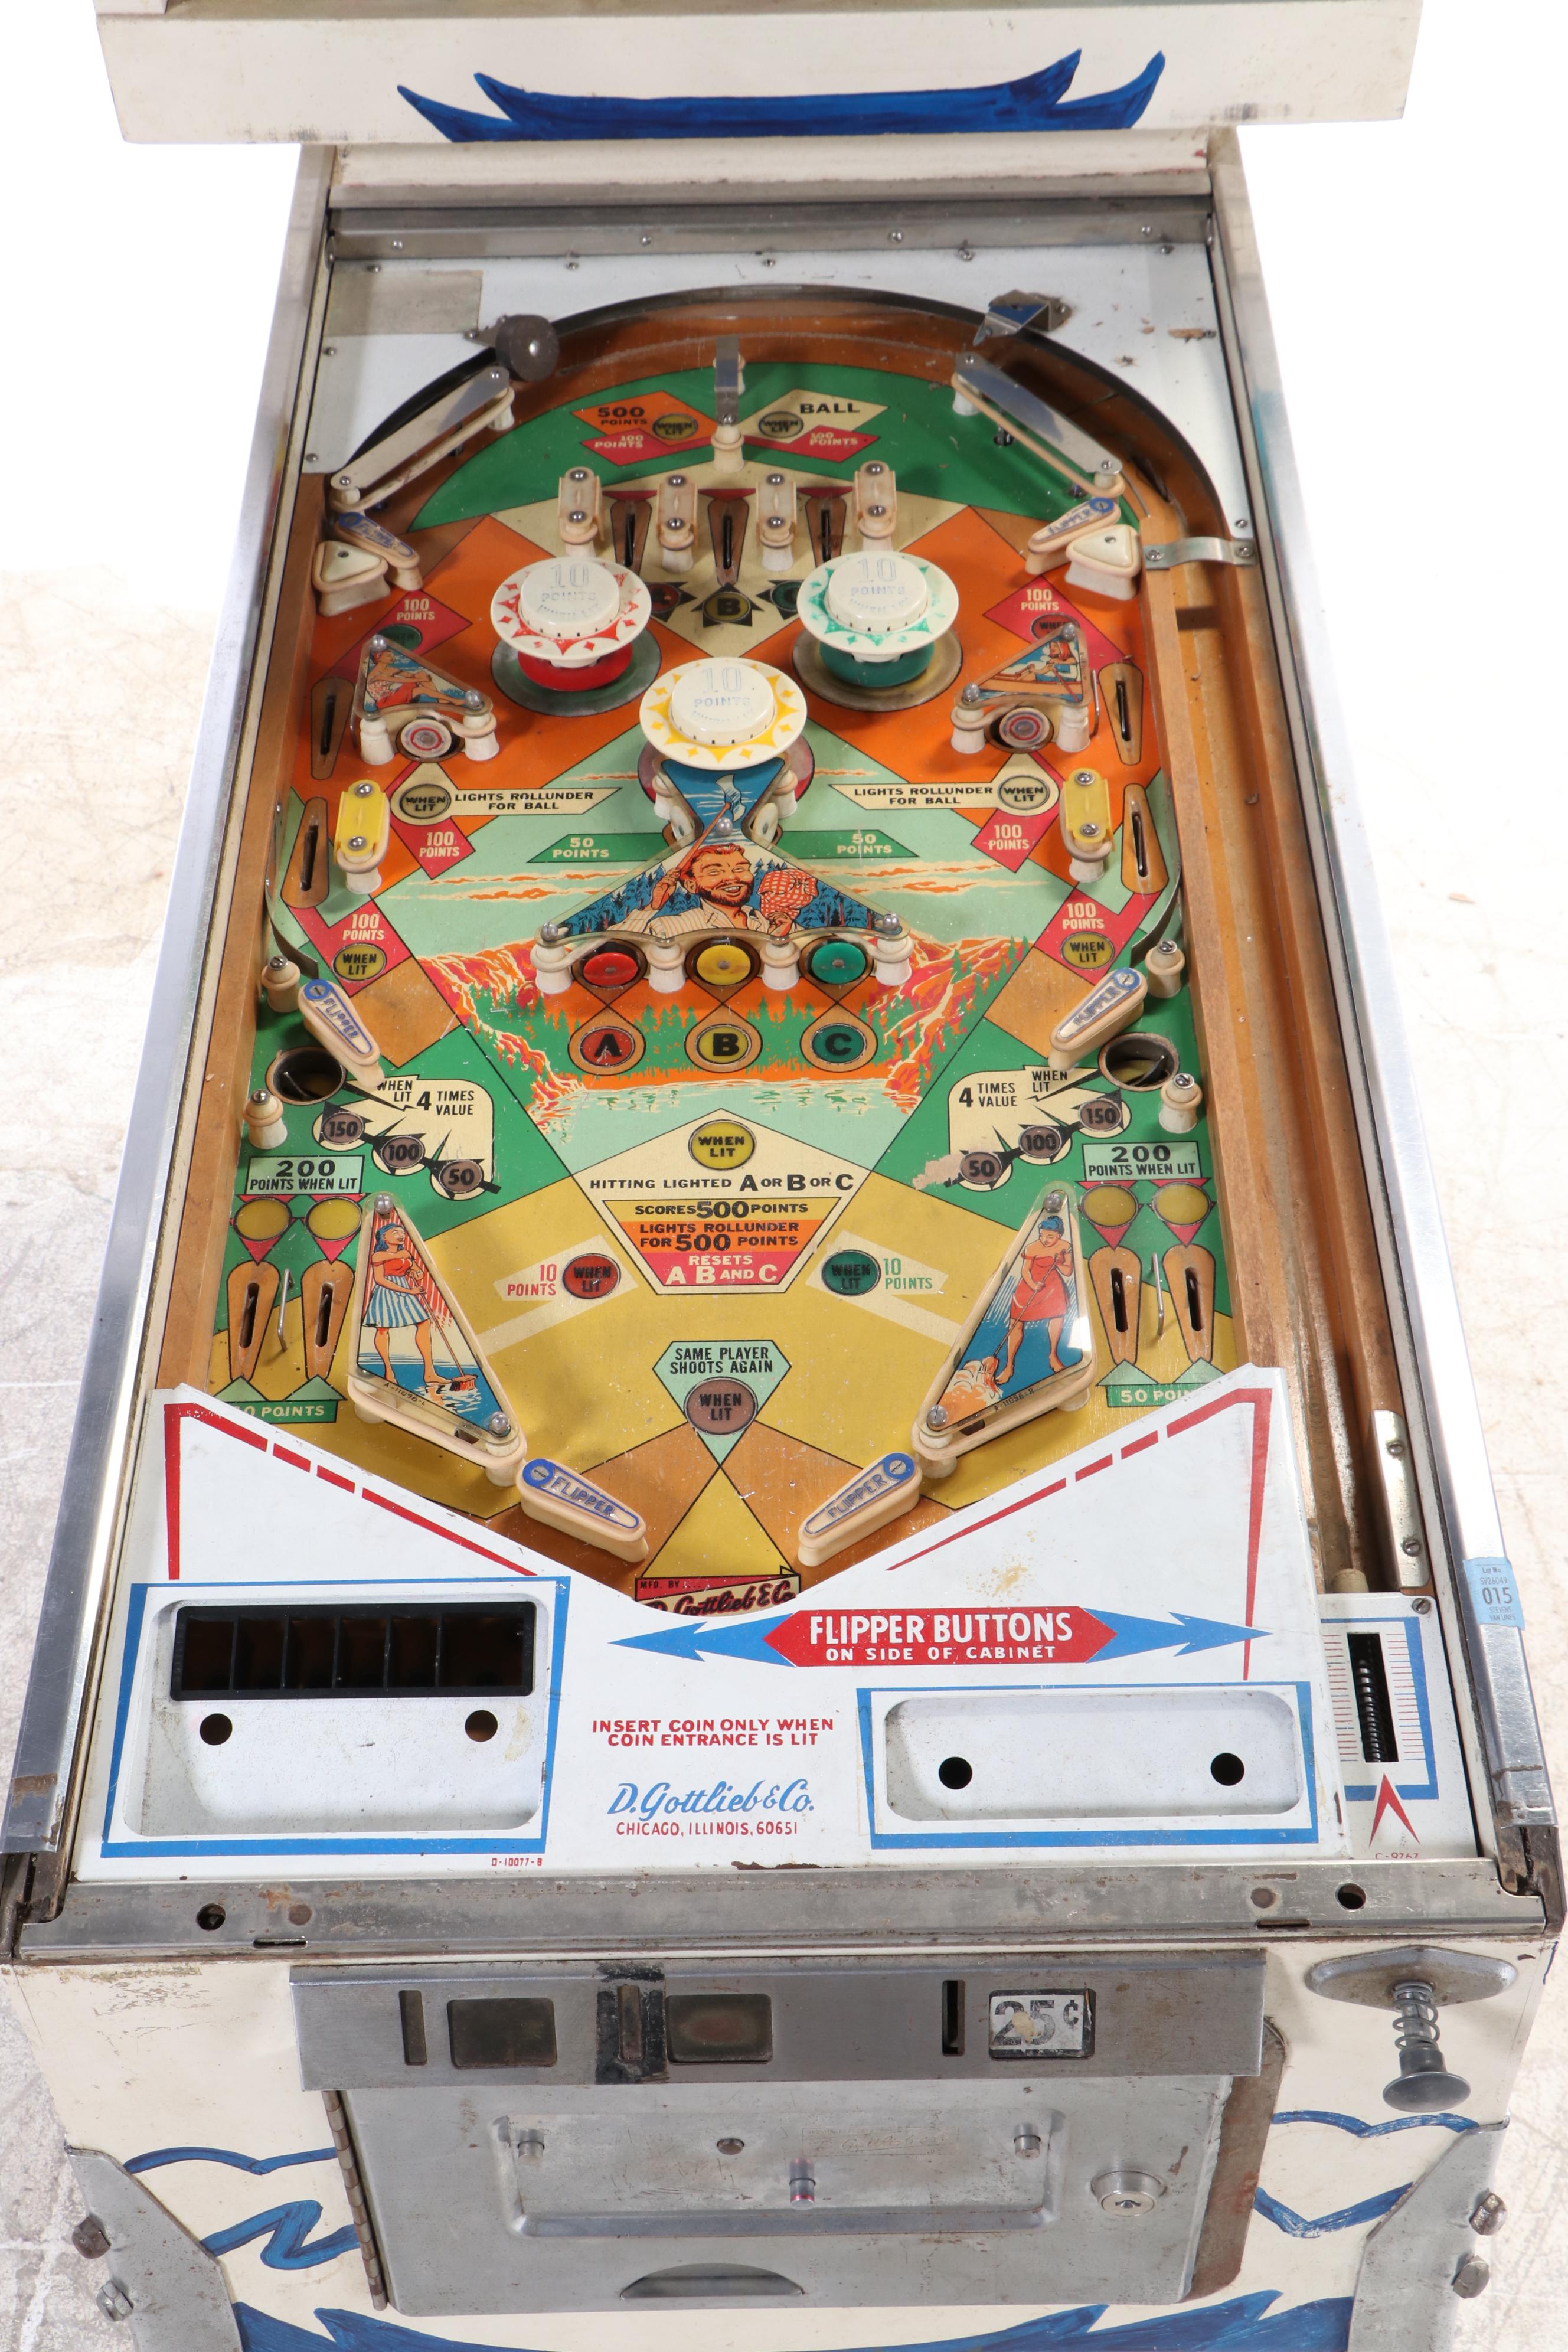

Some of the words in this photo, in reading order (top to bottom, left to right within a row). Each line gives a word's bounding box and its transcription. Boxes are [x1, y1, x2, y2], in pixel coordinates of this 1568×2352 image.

[598, 407, 645, 417] 500
[800, 403, 860, 413] BALL
[550, 563, 589, 589] 10
[858, 558, 897, 583] 10
[541, 592, 596, 602] POINTS
[851, 586, 905, 596] POINTS
[1027, 589, 1053, 602] 100
[404, 599, 429, 612] 100
[717, 598, 741, 615] B
[1021, 602, 1059, 611] POINTS
[397, 612, 435, 621] POINTS
[702, 667, 742, 693] 10
[694, 697, 751, 707] POINTS
[455, 793, 504, 802] LIGHTS
[510, 792, 593, 800] ROLLUNDER
[854, 787, 904, 796] LIGHTS
[910, 786, 993, 795] ROLLUNDER
[406, 796, 446, 804] WHEN
[488, 802, 516, 811] FOR
[414, 803, 436, 812] LIT
[994, 824, 1022, 838] 100
[426, 832, 454, 846] 100
[569, 837, 594, 848] 50
[852, 834, 877, 844] 50
[988, 839, 1030, 850] POINTS
[419, 847, 459, 857] POINTS
[553, 849, 610, 858] POINTS
[837, 845, 893, 854] POINTS
[1066, 903, 1096, 918] 100
[351, 913, 380, 929] 100
[1062, 918, 1105, 930] POINTS
[342, 930, 385, 940] POINTS
[1070, 941, 1105, 952] WHEN
[342, 953, 377, 963] WHEN
[1079, 953, 1097, 963] LIT
[348, 965, 367, 975] LIT
[324, 998, 359, 1039] FLIPPER
[593, 1033, 623, 1057] A
[712, 1033, 739, 1057] B
[825, 1033, 854, 1056] C
[1032, 1070, 1068, 1081] WHEN
[377, 1080, 413, 1092] WHEN
[977, 1082, 1015, 1094] TIMES
[1033, 1082, 1050, 1092] LIT
[393, 1091, 411, 1102] LIT
[416, 1091, 432, 1110] 4
[436, 1090, 475, 1102] TIMES
[959, 1087, 974, 1107] 4
[978, 1095, 1018, 1107] VALUE
[436, 1104, 474, 1116] VALUE
[1086, 1108, 1118, 1123] 150
[328, 1120, 358, 1138] 150
[698, 1136, 744, 1146] WHEN
[1026, 1134, 1057, 1151] 100
[388, 1144, 419, 1161] 100
[709, 1148, 736, 1157] LIT
[1111, 1145, 1171, 1162] 200
[276, 1159, 336, 1177] 200
[969, 1159, 994, 1177] 50
[1089, 1164, 1133, 1177] POINTS
[1136, 1163, 1173, 1176] WHEN
[1177, 1162, 1196, 1175] LIT
[447, 1168, 474, 1186] 50
[590, 1179, 655, 1189] HITTING
[663, 1178, 732, 1188] LIGHTED
[739, 1175, 759, 1191] A
[760, 1178, 782, 1187] OR
[787, 1175, 806, 1191] B
[809, 1177, 831, 1187] OR
[835, 1174, 854, 1191] C
[250, 1178, 294, 1191] POINTS
[299, 1178, 334, 1190] WHEN
[338, 1177, 358, 1190] LIT
[635, 1204, 696, 1215] SCORES
[695, 1201, 749, 1219] 500
[750, 1203, 808, 1214] POINTS
[639, 1223, 696, 1234] LIGHTS
[704, 1222, 799, 1233] ROLLUNDER
[640, 1237, 671, 1248] FOR
[675, 1234, 731, 1251] 500
[737, 1236, 798, 1246] POINTS
[688, 1255, 753, 1266] RESETS
[883, 1257, 901, 1275] 10
[540, 1263, 557, 1282] 10
[574, 1266, 612, 1279] WHEN
[666, 1266, 687, 1285] A
[696, 1266, 716, 1284] B
[720, 1269, 755, 1279] AND
[759, 1264, 778, 1282] C
[831, 1264, 870, 1276] WHEN
[507, 1283, 557, 1296] POINTS
[582, 1280, 601, 1292] LIT
[842, 1278, 861, 1290] LIT
[885, 1277, 933, 1289] POINTS
[675, 1348, 712, 1360] SAME
[720, 1347, 769, 1360] PLAYER
[670, 1361, 723, 1374] SHOOTS
[730, 1360, 773, 1373] AGAIN
[700, 1393, 742, 1406] WHEN
[1121, 1389, 1148, 1403] 50
[261, 1406, 325, 1417] POINTS
[711, 1408, 732, 1420] LIT
[550, 1476, 615, 1517] FLIPPER
[827, 1474, 888, 1518] FLIPPER
[640, 1580, 662, 1589] MFD.
[1482, 1587, 1513, 1605] 015
[810, 1615, 925, 1644] FLIPPER
[933, 1612, 1073, 1643] BUTTONS
[825, 1647, 853, 1661] ON
[865, 1648, 914, 1661] SIDE
[927, 1647, 953, 1660] OF
[966, 1645, 1056, 1659] CABINET
[592, 1720, 662, 1733] INSERT
[669, 1719, 715, 1733] COIN
[720, 1719, 770, 1732] ONLY
[776, 1719, 834, 1731] WHEN
[608, 1734, 654, 1747] COIN
[661, 1733, 759, 1746] ENTRANCE
[766, 1733, 784, 1746] IS
[791, 1733, 818, 1746] LIT
[616, 1822, 684, 1837] CHICAGO,
[689, 1822, 753, 1836] ILLINOIS,
[756, 1821, 798, 1835] 60651
